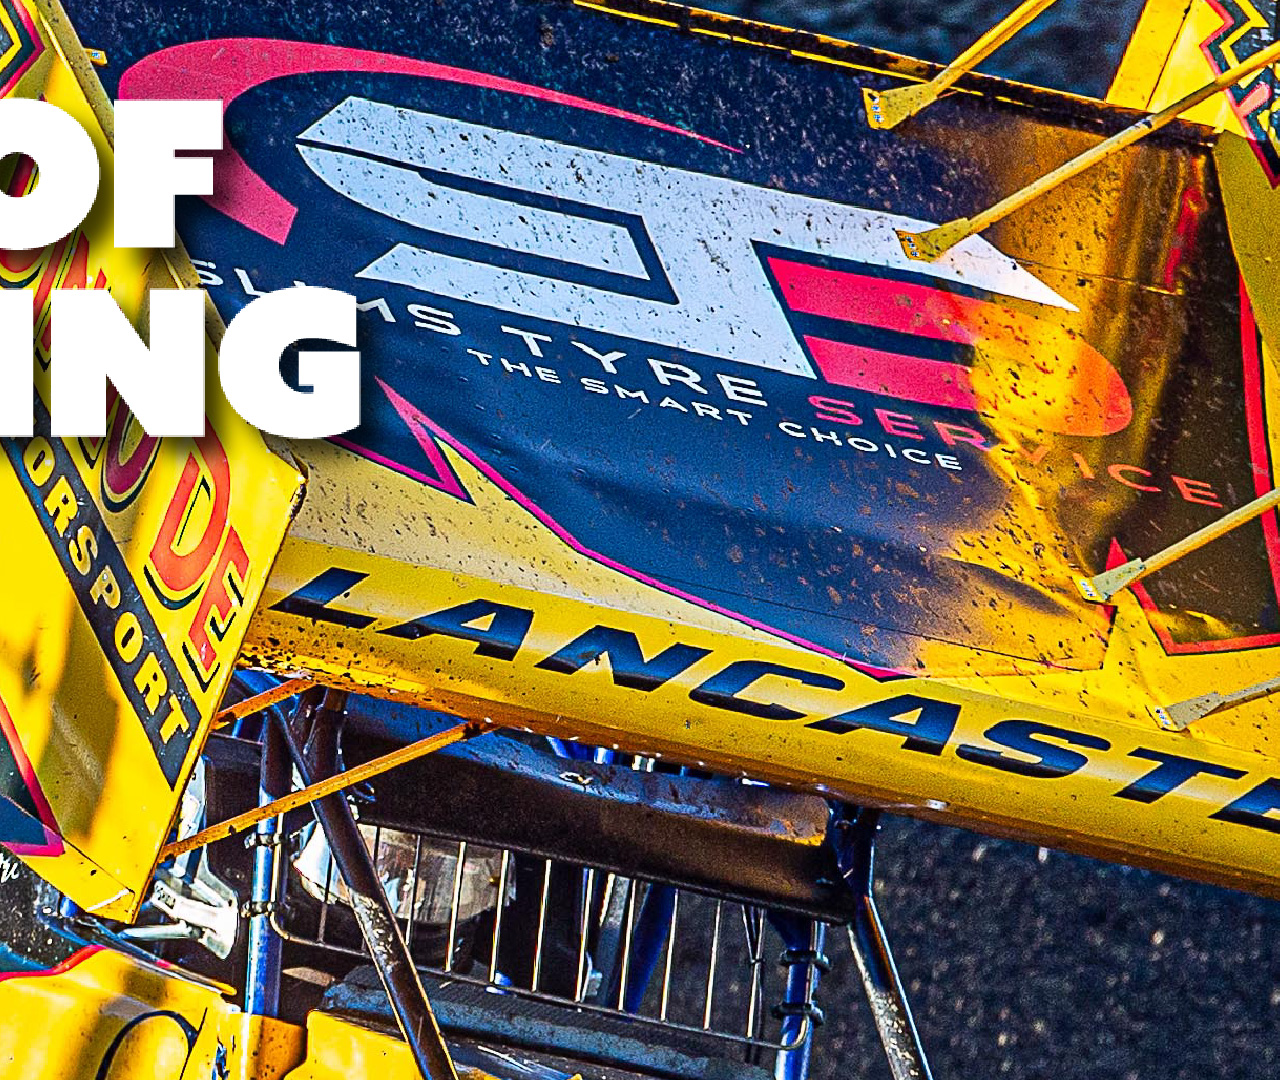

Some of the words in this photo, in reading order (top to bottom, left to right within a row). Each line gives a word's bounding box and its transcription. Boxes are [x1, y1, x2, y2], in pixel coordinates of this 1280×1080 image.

[467, 348, 562, 384] THE
[580, 377, 753, 427] SMART
[777, 421, 965, 472] CHOICE
[501, 325, 768, 407] TYRE
[807, 394, 1224, 509] SERVICE
